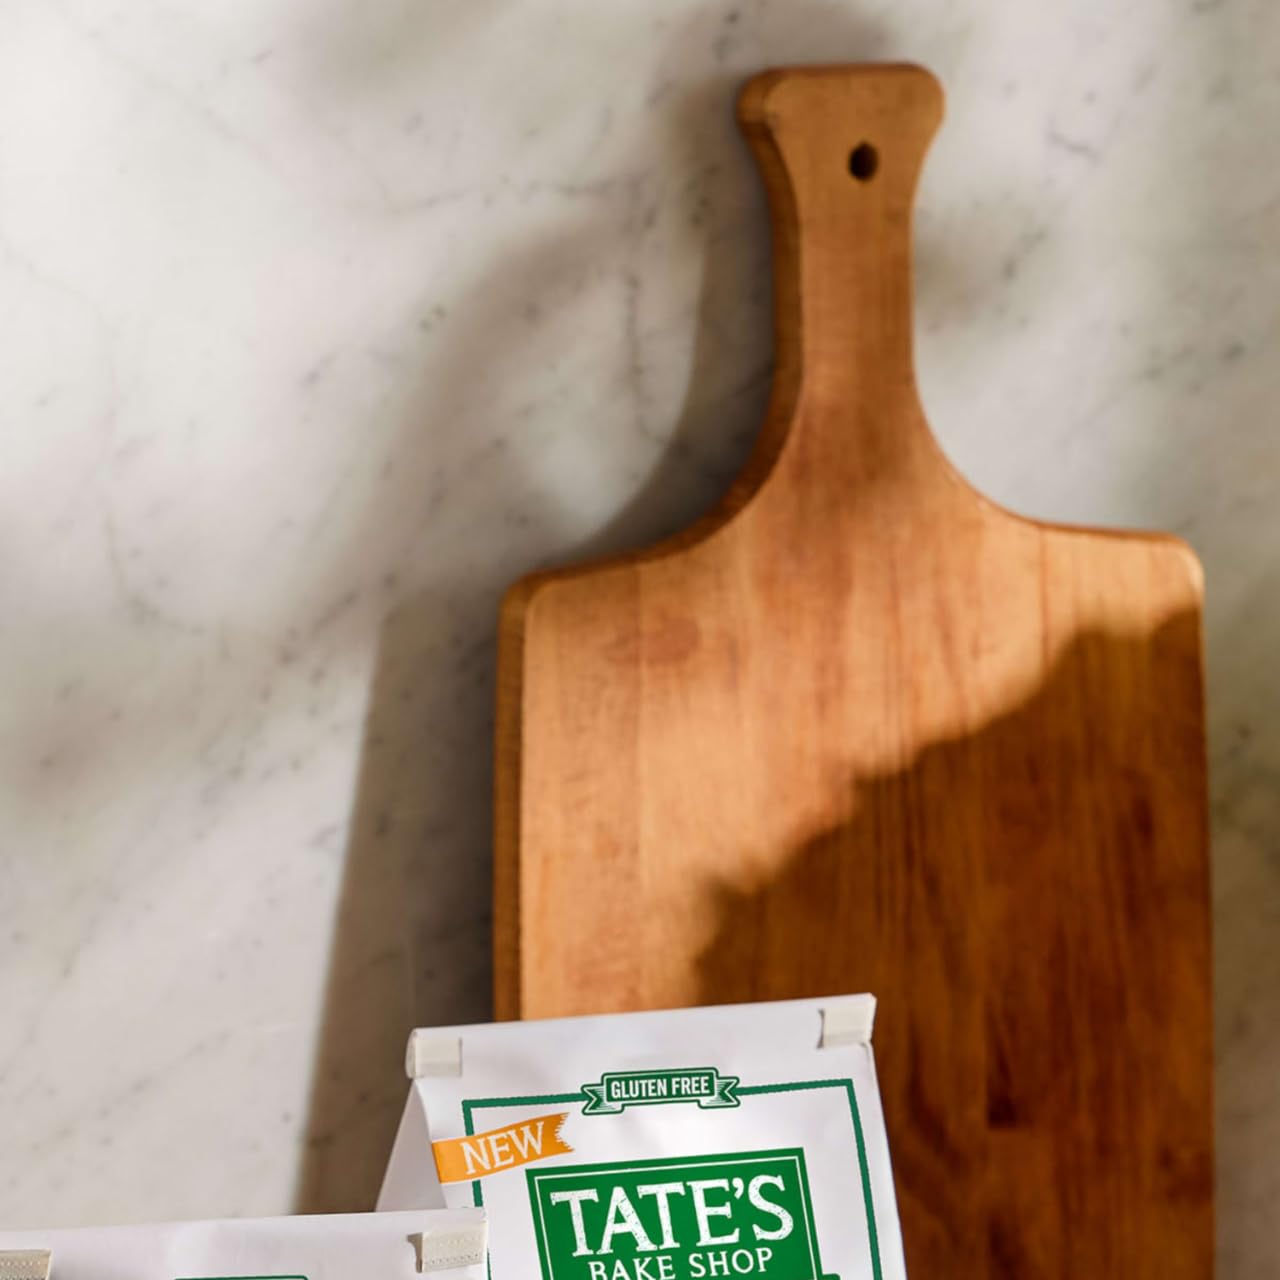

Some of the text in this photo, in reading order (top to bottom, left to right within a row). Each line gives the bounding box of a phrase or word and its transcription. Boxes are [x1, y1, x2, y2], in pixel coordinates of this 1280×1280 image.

[610, 1075, 710, 1099] GLUTEN FREE
[460, 1122, 545, 1176] NEW
[550, 1174, 795, 1258] TATE'S
[690, 1246, 774, 1280] SHOP
